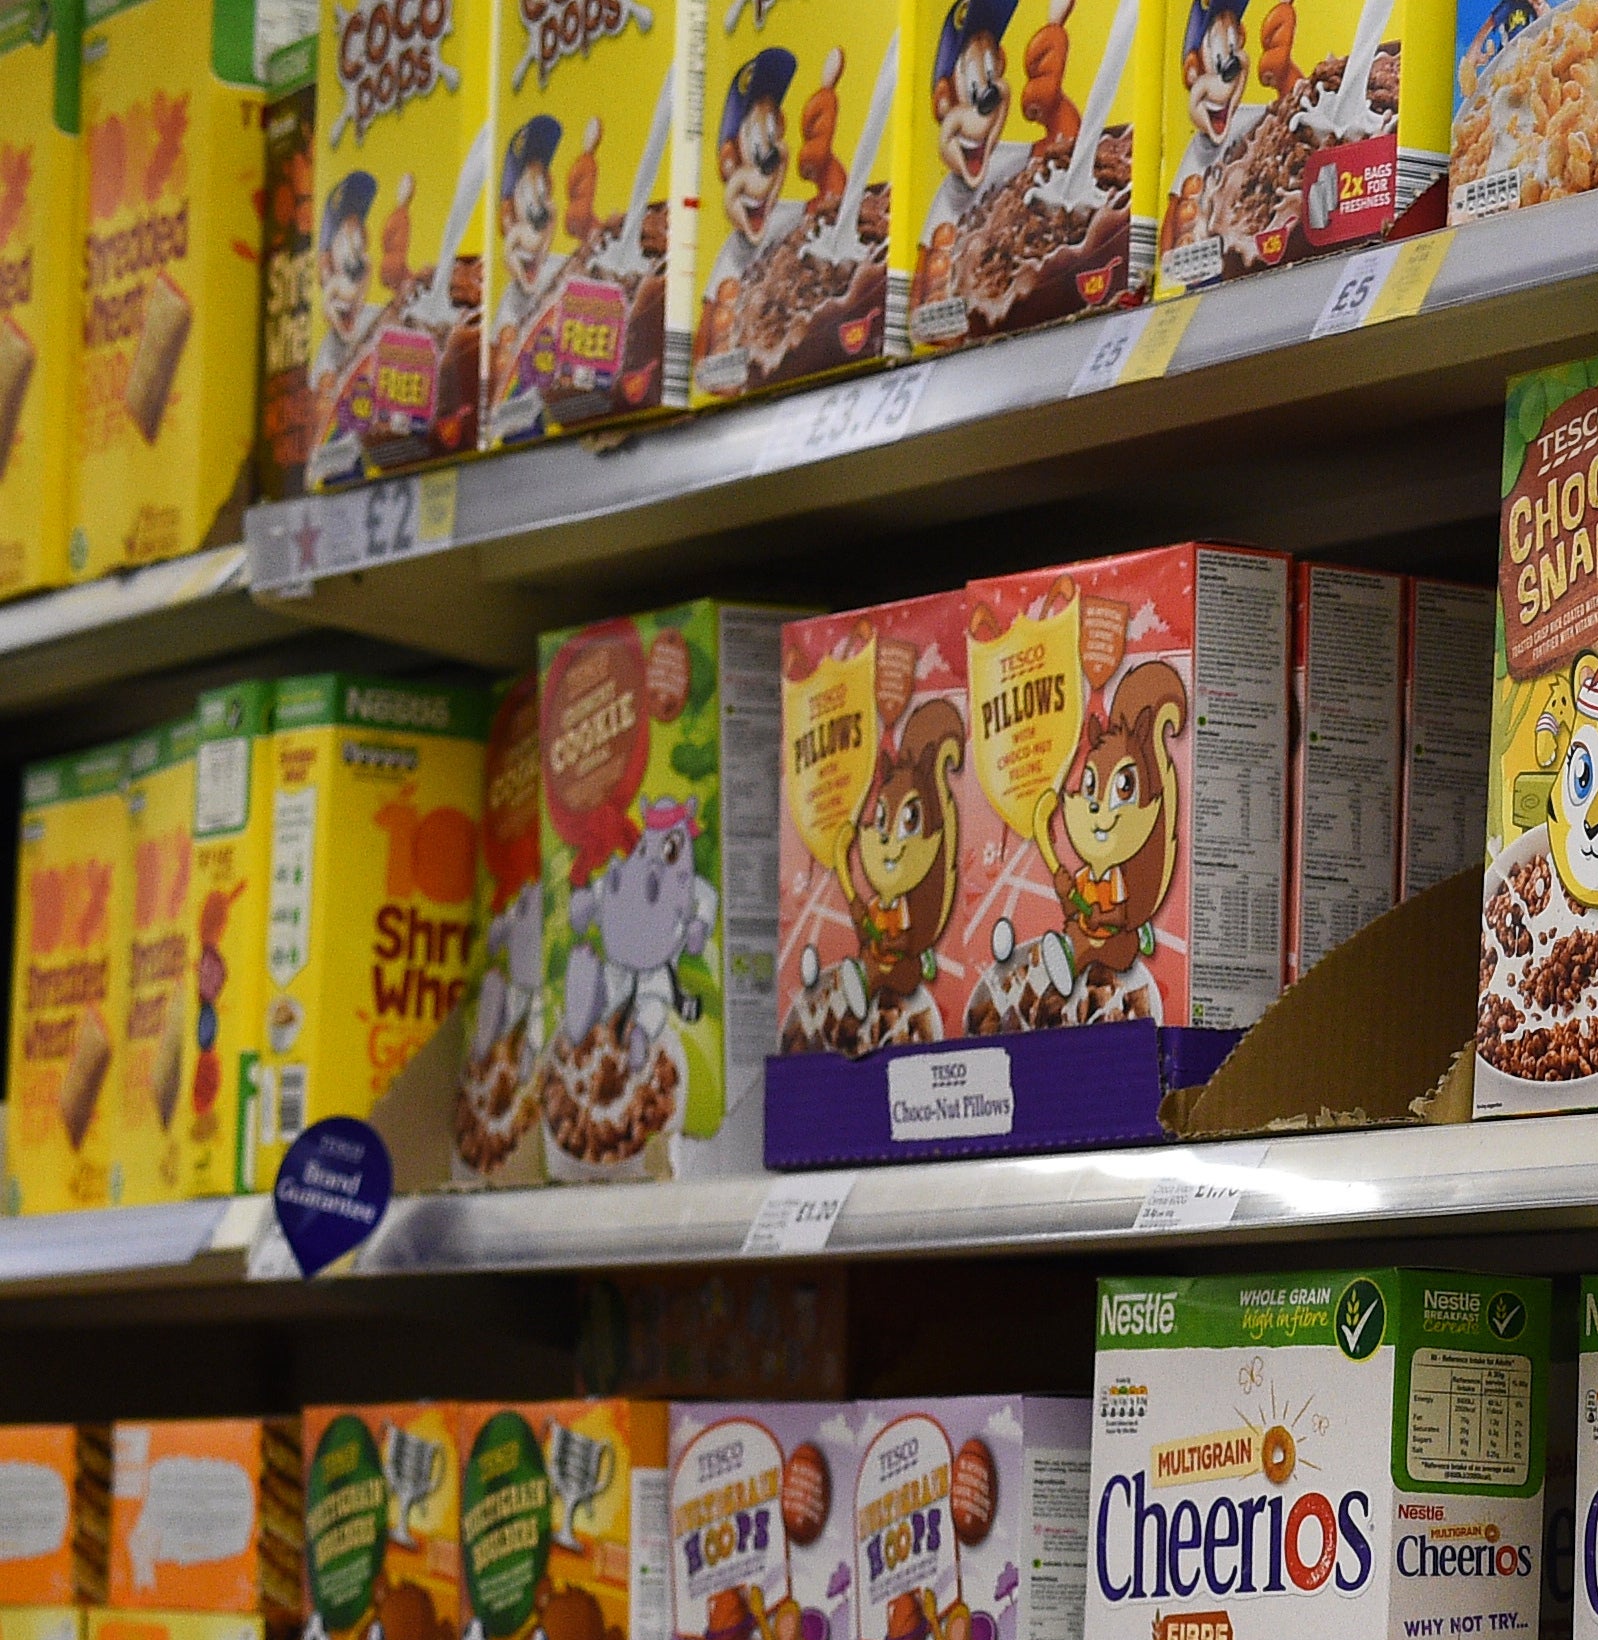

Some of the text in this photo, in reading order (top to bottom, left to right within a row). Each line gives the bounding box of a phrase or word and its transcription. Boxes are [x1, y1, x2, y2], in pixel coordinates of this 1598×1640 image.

[1340, 171, 1363, 200] 2x
[1364, 163, 1392, 180] BAGS
[1367, 179, 1388, 195] FOR
[1340, 193, 1390, 214] FRESHNESS
[1331, 273, 1375, 314] £5
[563, 315, 620, 359] FREE!
[1089, 336, 1128, 373] £5
[804, 369, 923, 445] £3.75
[366, 491, 416, 554] £2
[1563, 603, 1584, 626] COATED
[1001, 644, 1044, 673] TESCO
[982, 673, 1065, 739] PILLOWS
[963, 1094, 1010, 1118] Pillows
[304, 1161, 361, 1196] Brand
[277, 1181, 378, 1226] Guarantee
[1240, 1288, 1331, 1306] WHOLE GRAIN
[1243, 1307, 1273, 1340] high
[1423, 1310, 1480, 1322] BREAKFAST
[1158, 1437, 1253, 1479] MULTIGRAIN
[1097, 1470, 1372, 1602] Cheerios
[1430, 1525, 1482, 1540] MULTIGRAIN
[1396, 1534, 1533, 1578] Cheerios
[1404, 1616, 1443, 1637] WHY
[1450, 1615, 1483, 1635] NOT
